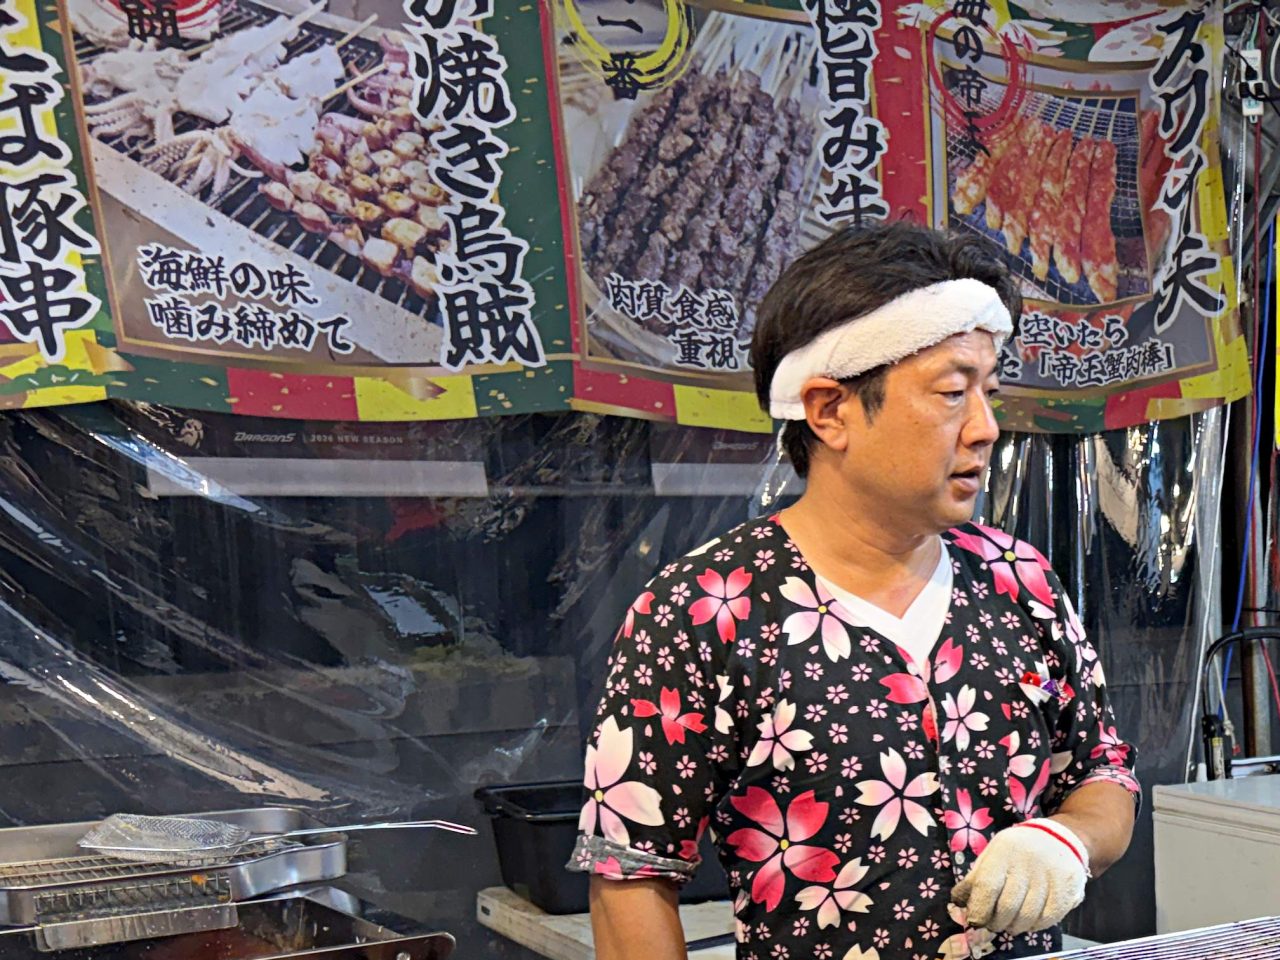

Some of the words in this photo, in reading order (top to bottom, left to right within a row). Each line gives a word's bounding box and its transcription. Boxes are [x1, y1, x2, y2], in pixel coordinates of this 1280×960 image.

[141, 247, 316, 304] 海鮮の味
[610, 278, 738, 328] 肉質食感
